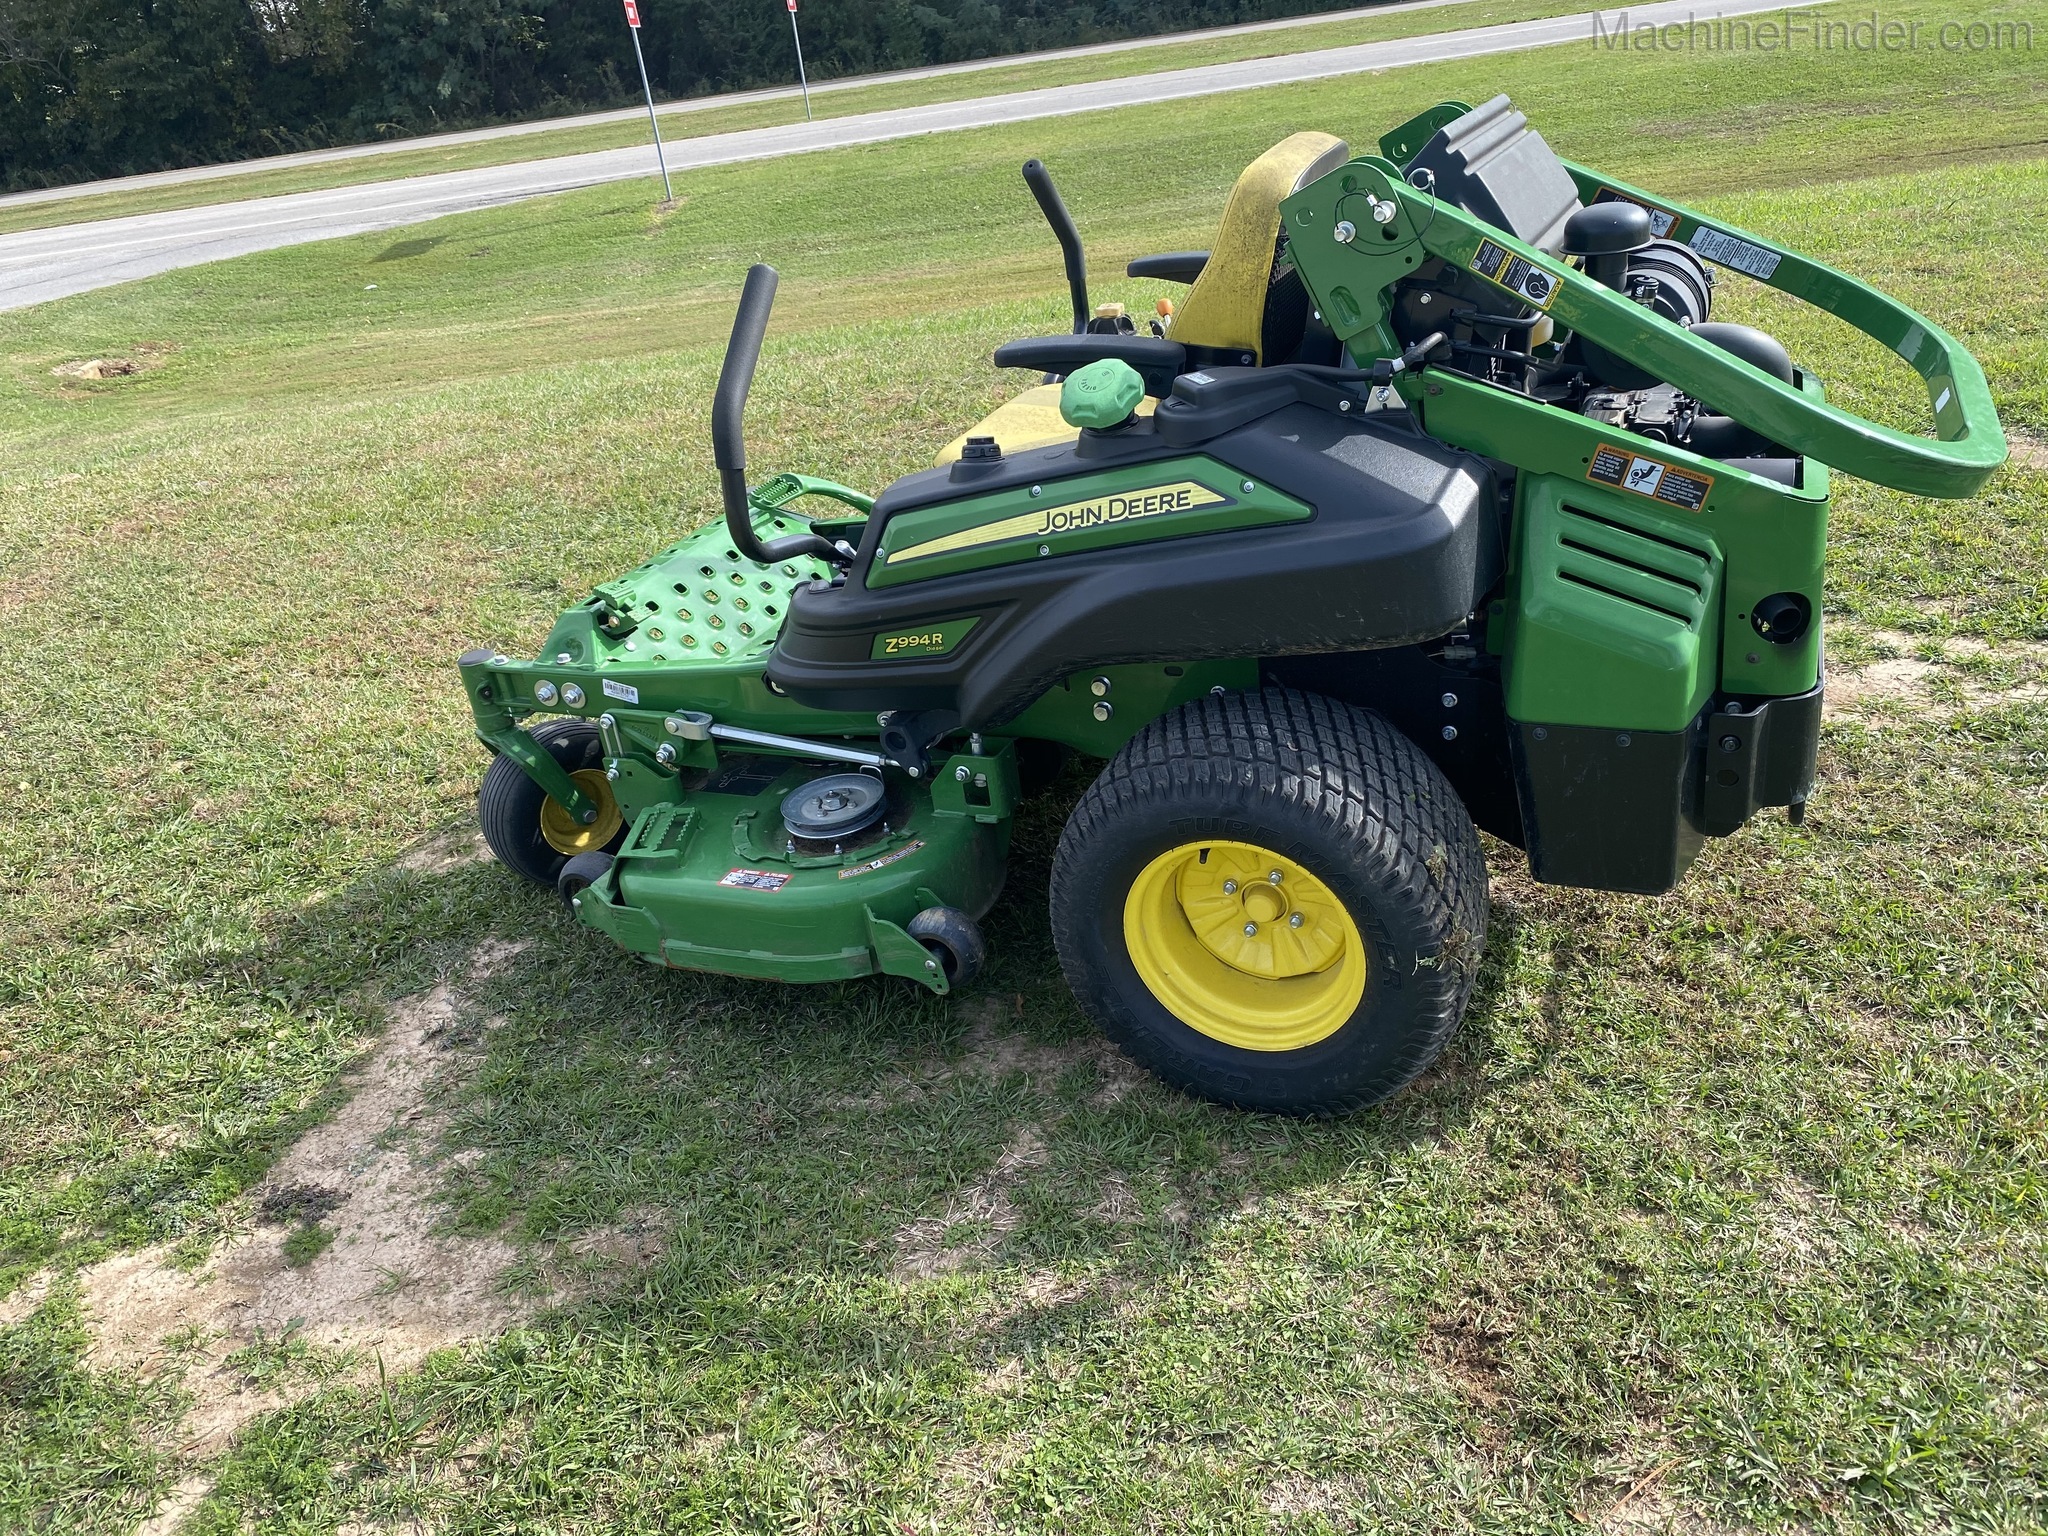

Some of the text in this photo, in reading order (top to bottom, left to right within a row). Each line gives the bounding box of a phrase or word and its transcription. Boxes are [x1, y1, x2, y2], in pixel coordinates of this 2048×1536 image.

[1677, 469, 1709, 482] ADVERTENCIA
[1037, 489, 1193, 534] JOHN DEERE
[884, 632, 944, 653] Z994R
[1168, 816, 1402, 992] TURF MASTER
